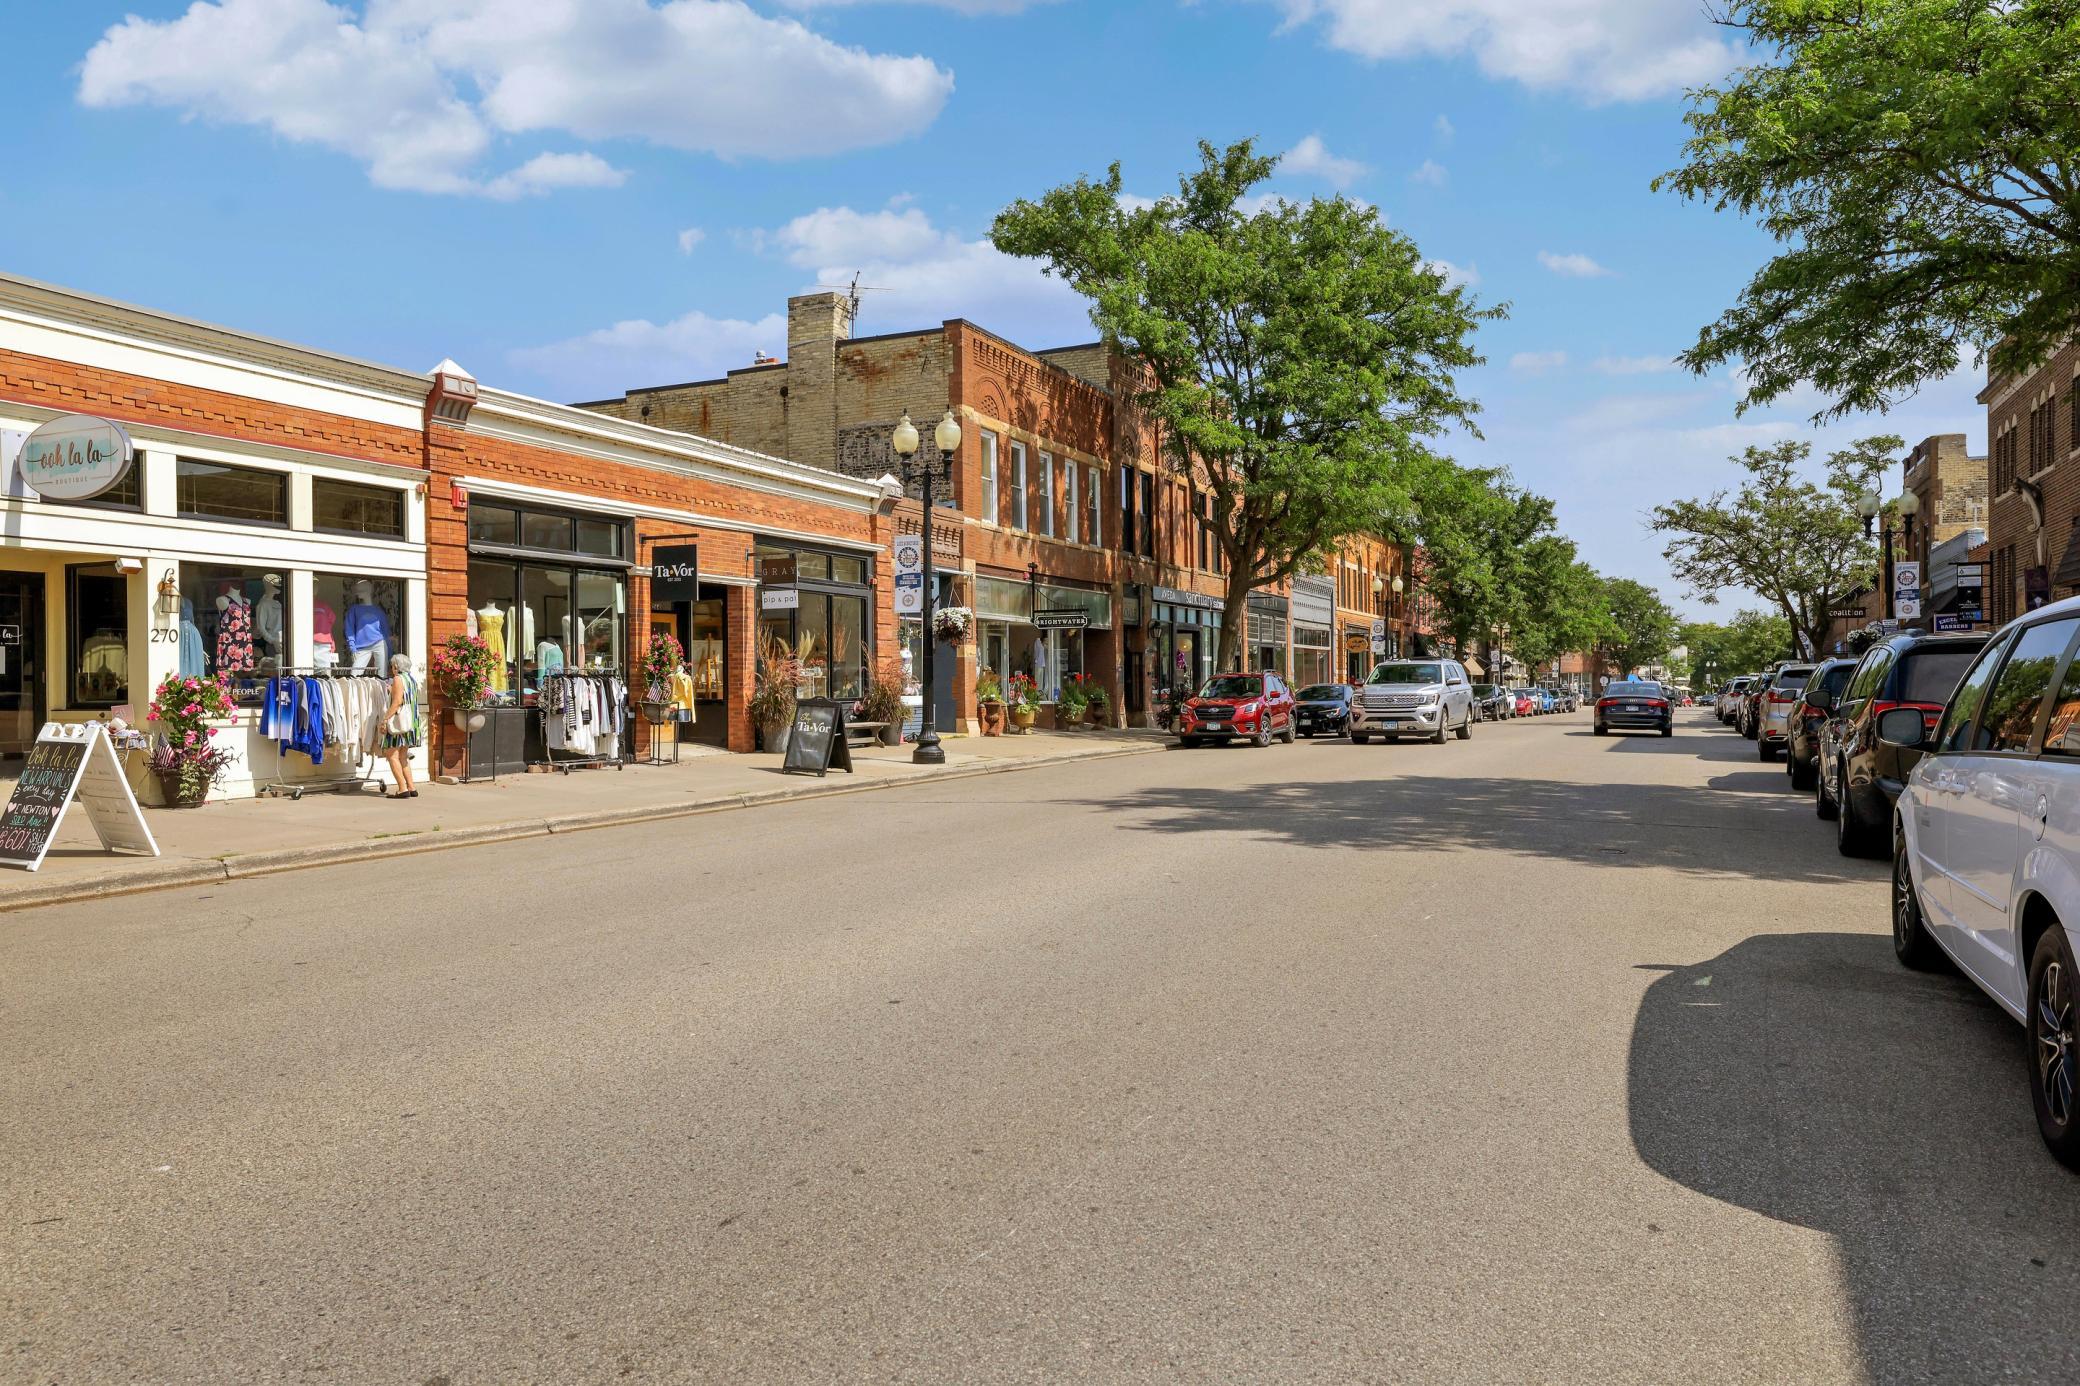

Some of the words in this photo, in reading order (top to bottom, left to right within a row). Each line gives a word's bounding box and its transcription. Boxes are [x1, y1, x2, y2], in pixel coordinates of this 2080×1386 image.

[30, 443, 65, 469] ooh
[68, 441, 83, 466] la
[87, 439, 112, 463] la
[762, 566, 796, 576] GRAY
[1828, 608, 1864, 617] coalition
[1035, 618, 1086, 626] BRIGHTWATER
[151, 628, 178, 643] 270
[232, 688, 259, 696] PEOPLE
[50, 745, 62, 767] la
[64, 745, 79, 768] la
[23, 785, 40, 796] every
[42, 785, 55, 801] day
[21, 804, 51, 816] NEWTON
[5, 830, 31, 850] 60%
